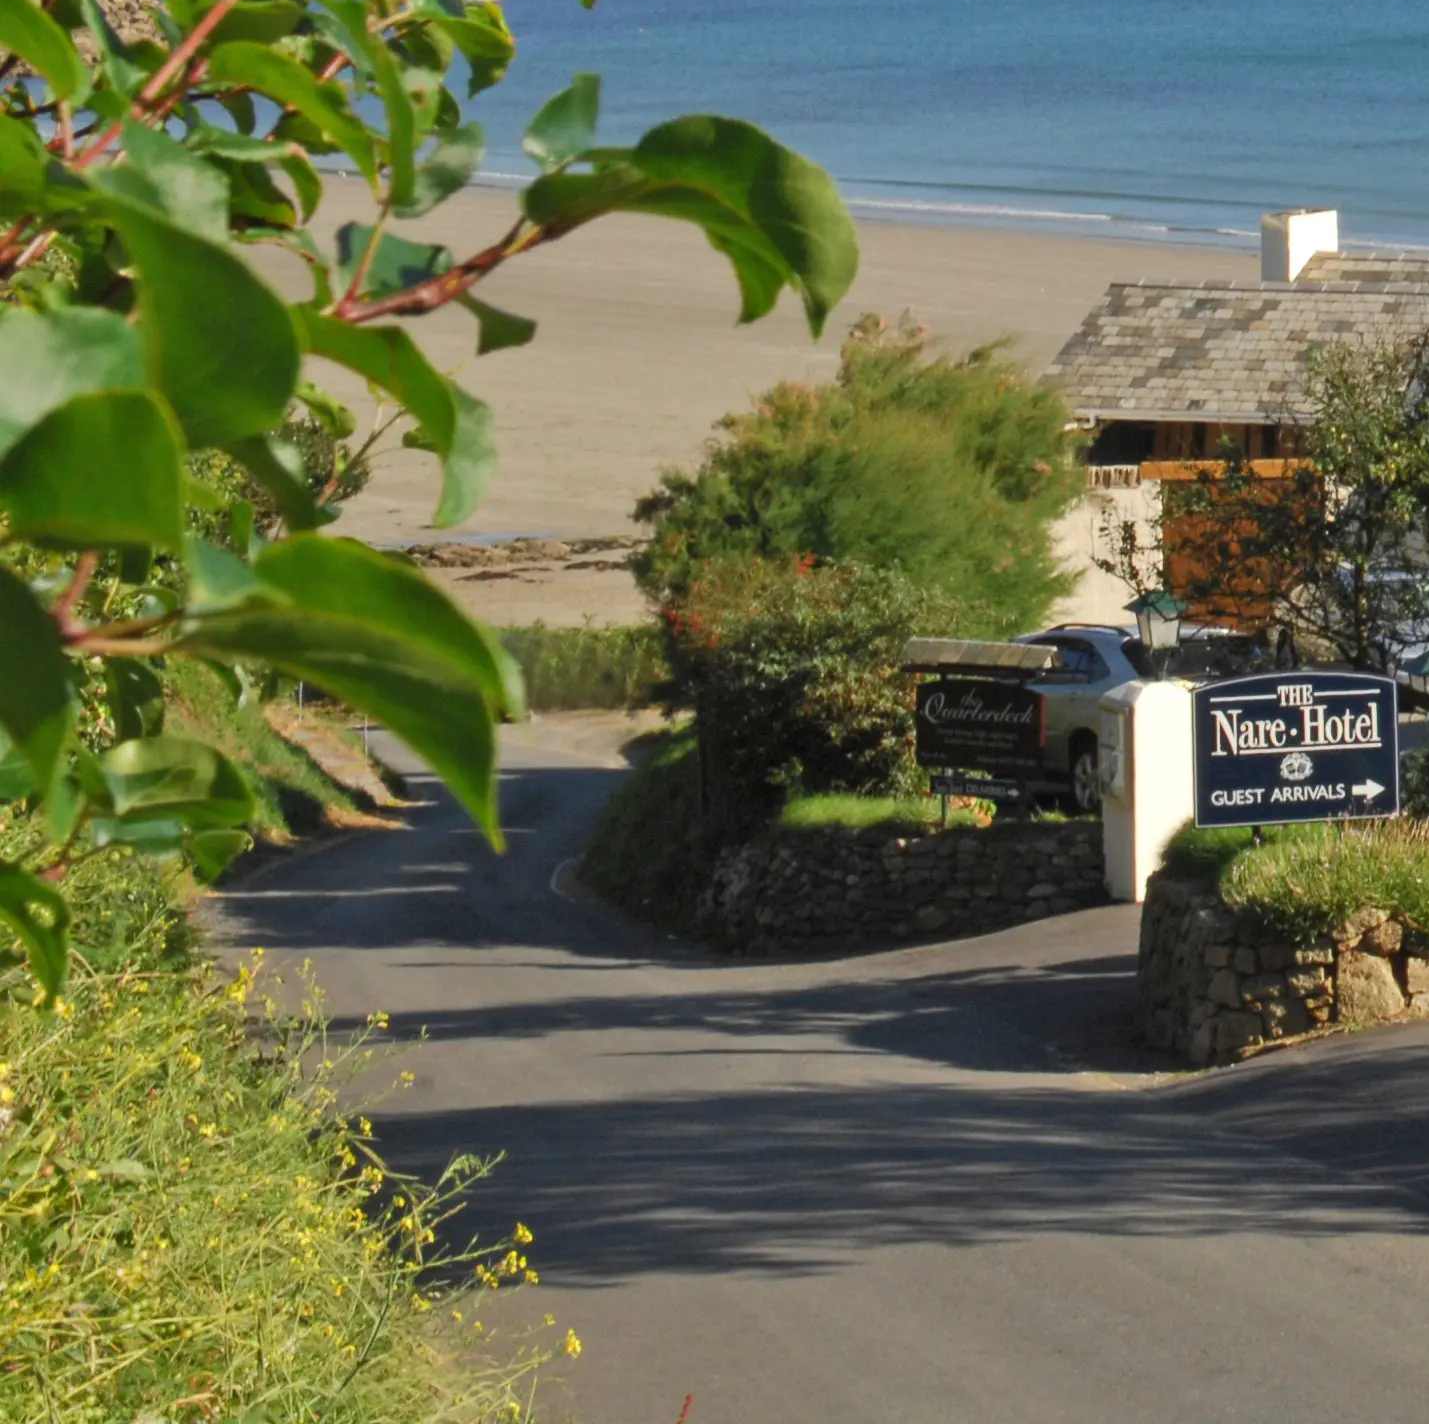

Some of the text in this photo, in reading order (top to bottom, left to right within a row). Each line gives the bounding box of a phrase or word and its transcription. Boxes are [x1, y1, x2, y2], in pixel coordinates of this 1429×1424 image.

[920, 692, 1033, 723] Quarterdeck
[1277, 684, 1313, 706] THE
[1210, 702, 1381, 756] Nare Hotel
[1211, 783, 1346, 806] GUEST ARRIVALS
